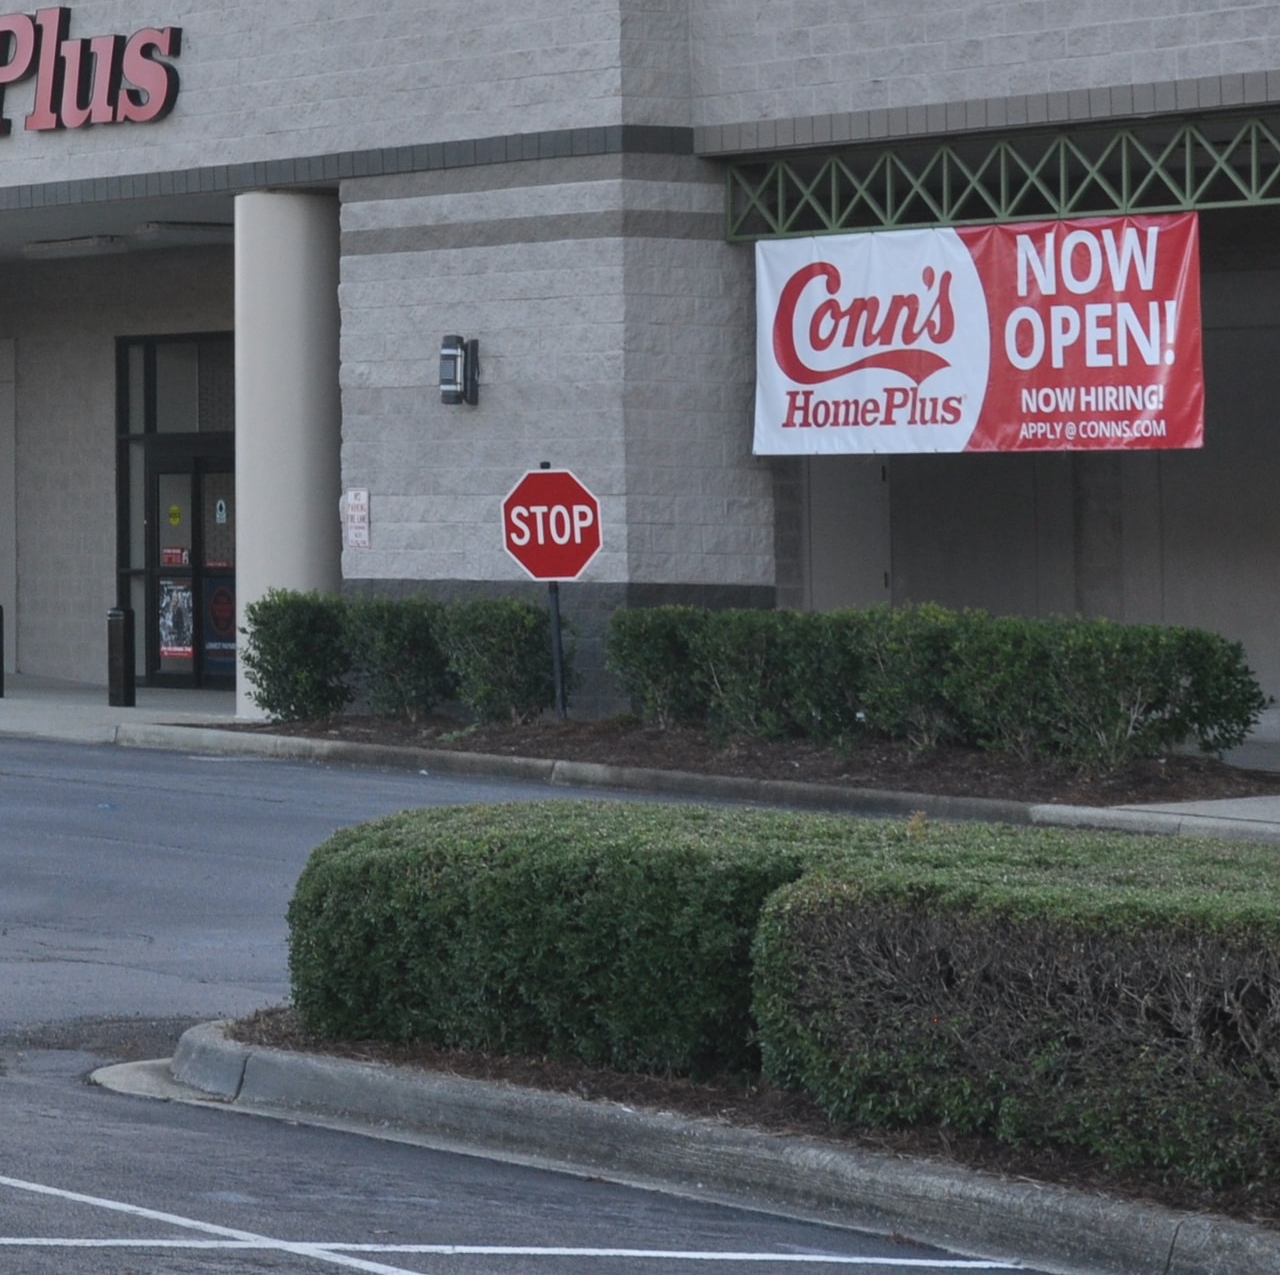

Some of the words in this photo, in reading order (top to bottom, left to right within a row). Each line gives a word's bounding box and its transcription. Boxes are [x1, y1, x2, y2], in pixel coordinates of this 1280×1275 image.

[1016, 227, 1159, 297] NOW
[772, 261, 955, 385] Conn's
[1004, 300, 1177, 370] OPEN!
[781, 386, 963, 428] HomePlus
[1021, 387, 1076, 413] NOW
[1080, 384, 1164, 412] HIRING!
[1019, 422, 1062, 439] APPLY
[1065, 423, 1076, 439] @
[1079, 420, 1167, 438] CONNS.COM
[510, 505, 594, 546] STOP
